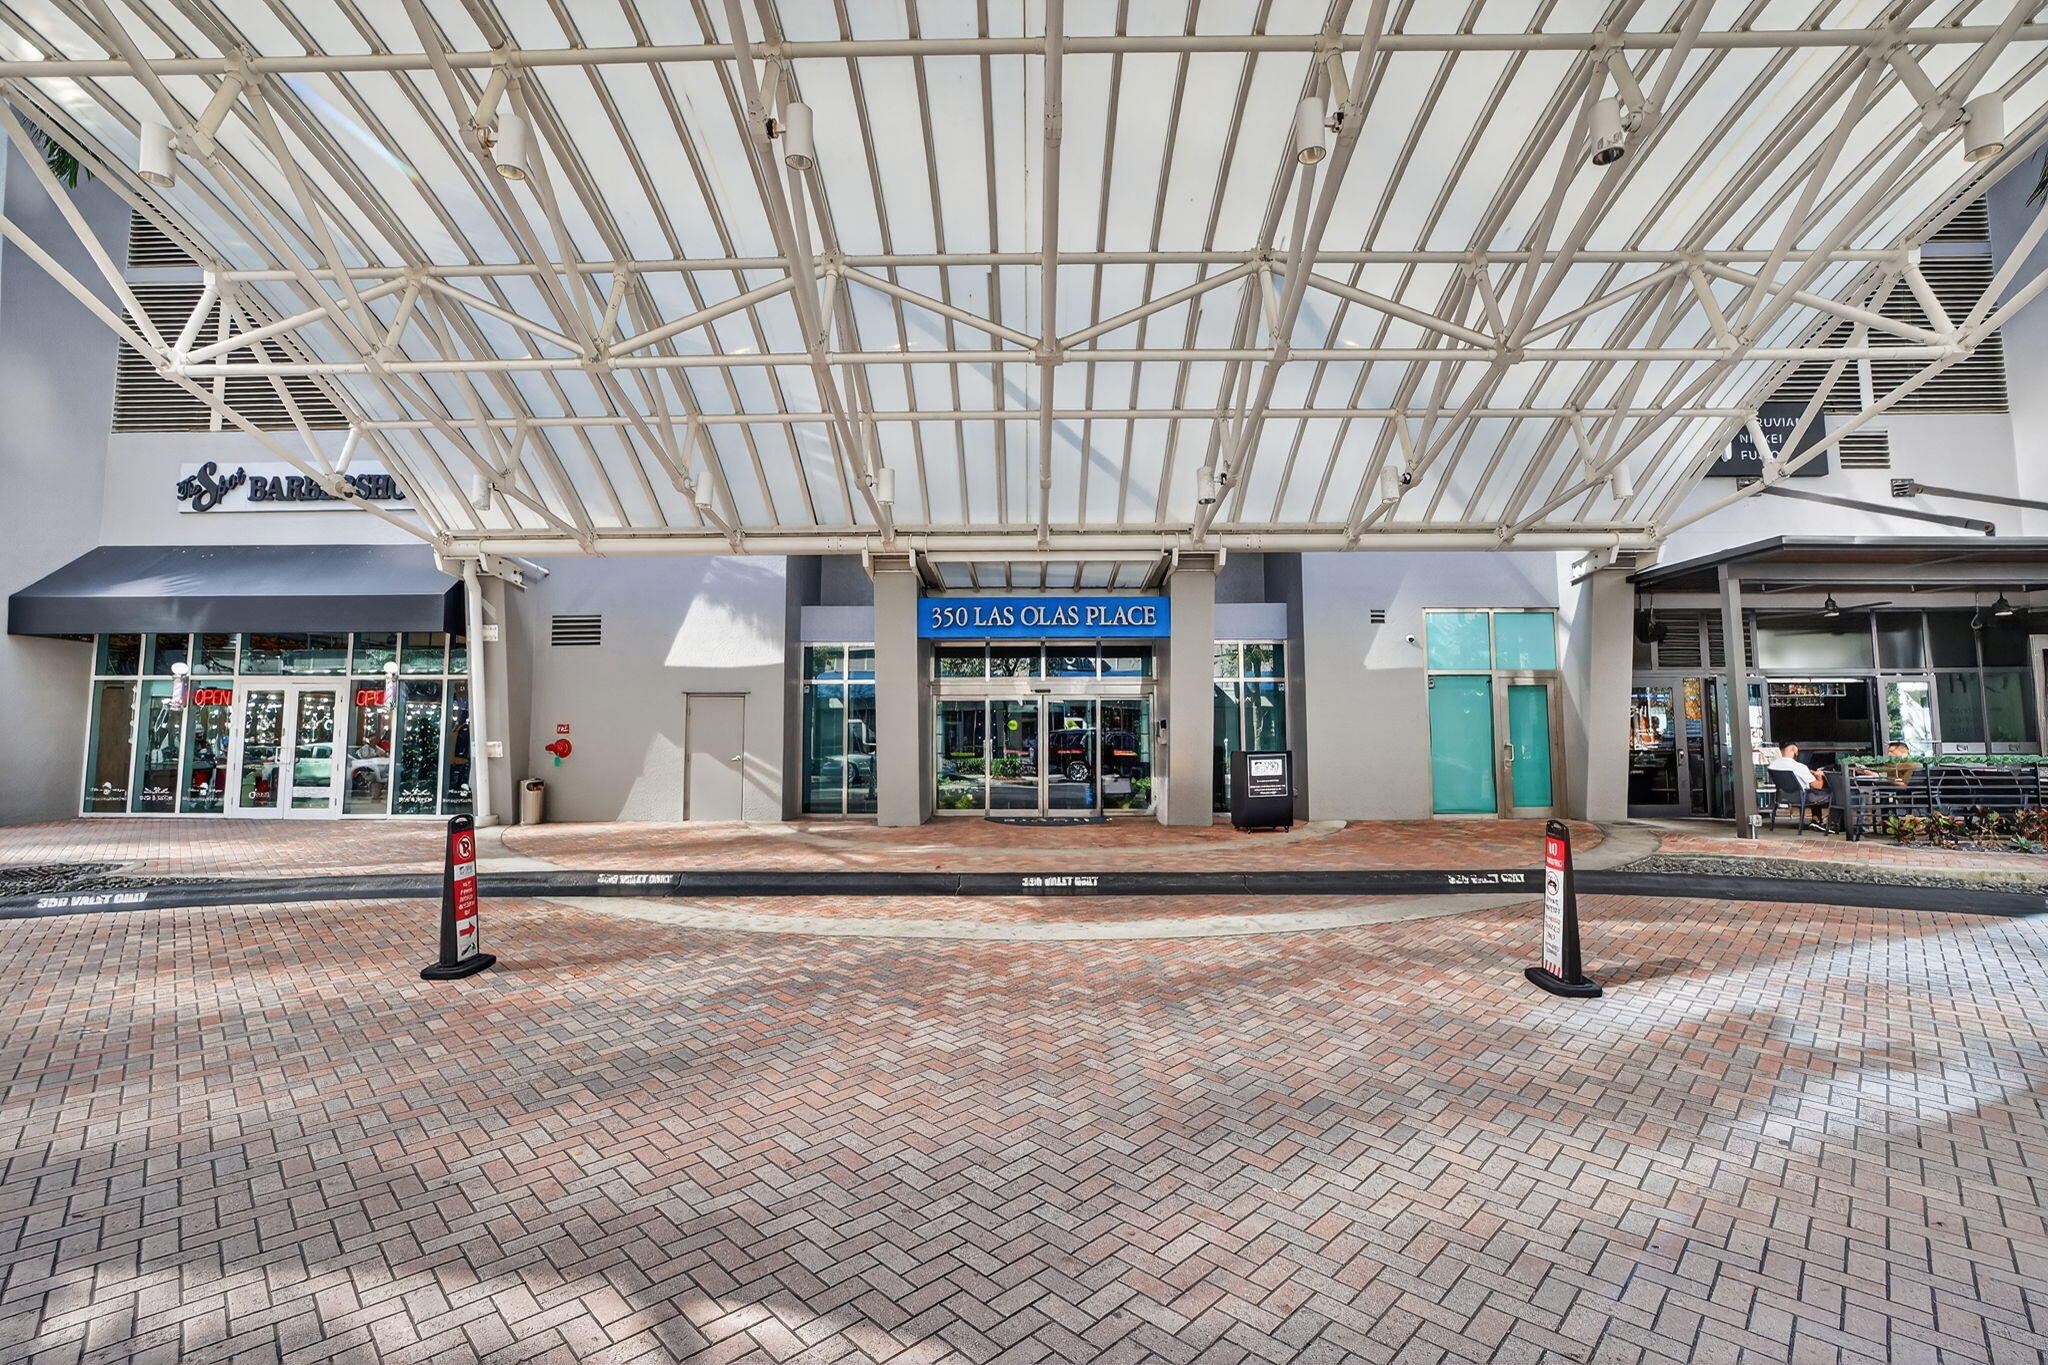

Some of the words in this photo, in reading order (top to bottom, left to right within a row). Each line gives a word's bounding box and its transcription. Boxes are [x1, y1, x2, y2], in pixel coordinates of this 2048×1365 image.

[1758, 417, 1801, 427] RUVIA
[1740, 433, 1782, 444] NIKEI
[1741, 450, 1781, 461] FUO
[176, 475, 202, 500] The
[192, 461, 247, 512] Spot
[932, 607, 968, 628] 350
[974, 606, 1015, 626] LAS
[1020, 605, 1079, 626] OLAS
[1085, 605, 1157, 626] PLACE
[195, 689, 231, 706] OPEN
[356, 690, 387, 706] OPE
[37, 897, 69, 909] 350
[71, 894, 113, 906] VALET
[114, 892, 149, 904] ONLY
